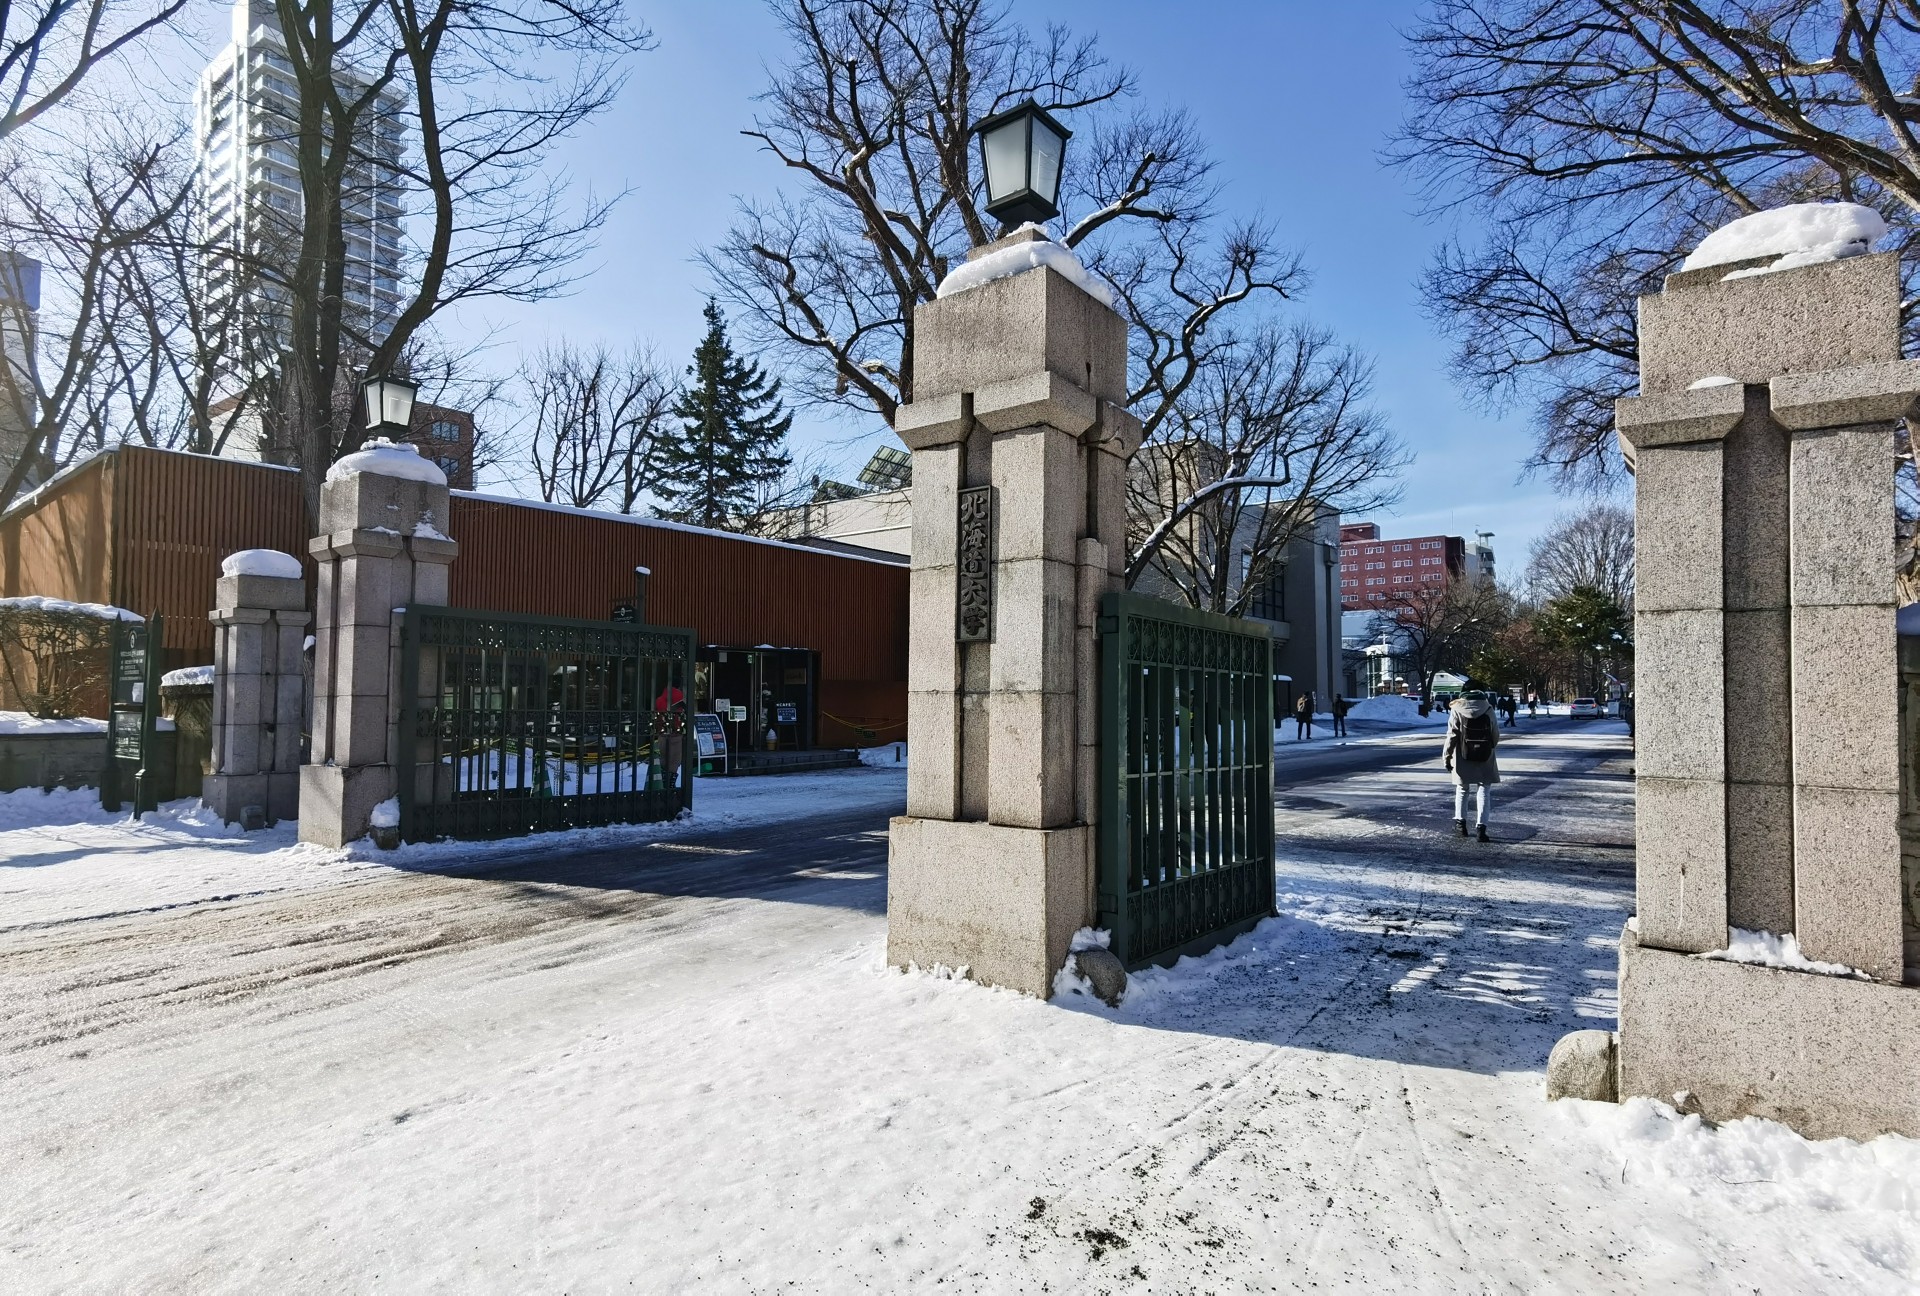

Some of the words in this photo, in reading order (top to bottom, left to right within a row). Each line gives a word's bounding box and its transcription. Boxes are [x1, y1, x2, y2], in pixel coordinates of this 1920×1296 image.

[960, 493, 988, 636] 北海道大学
